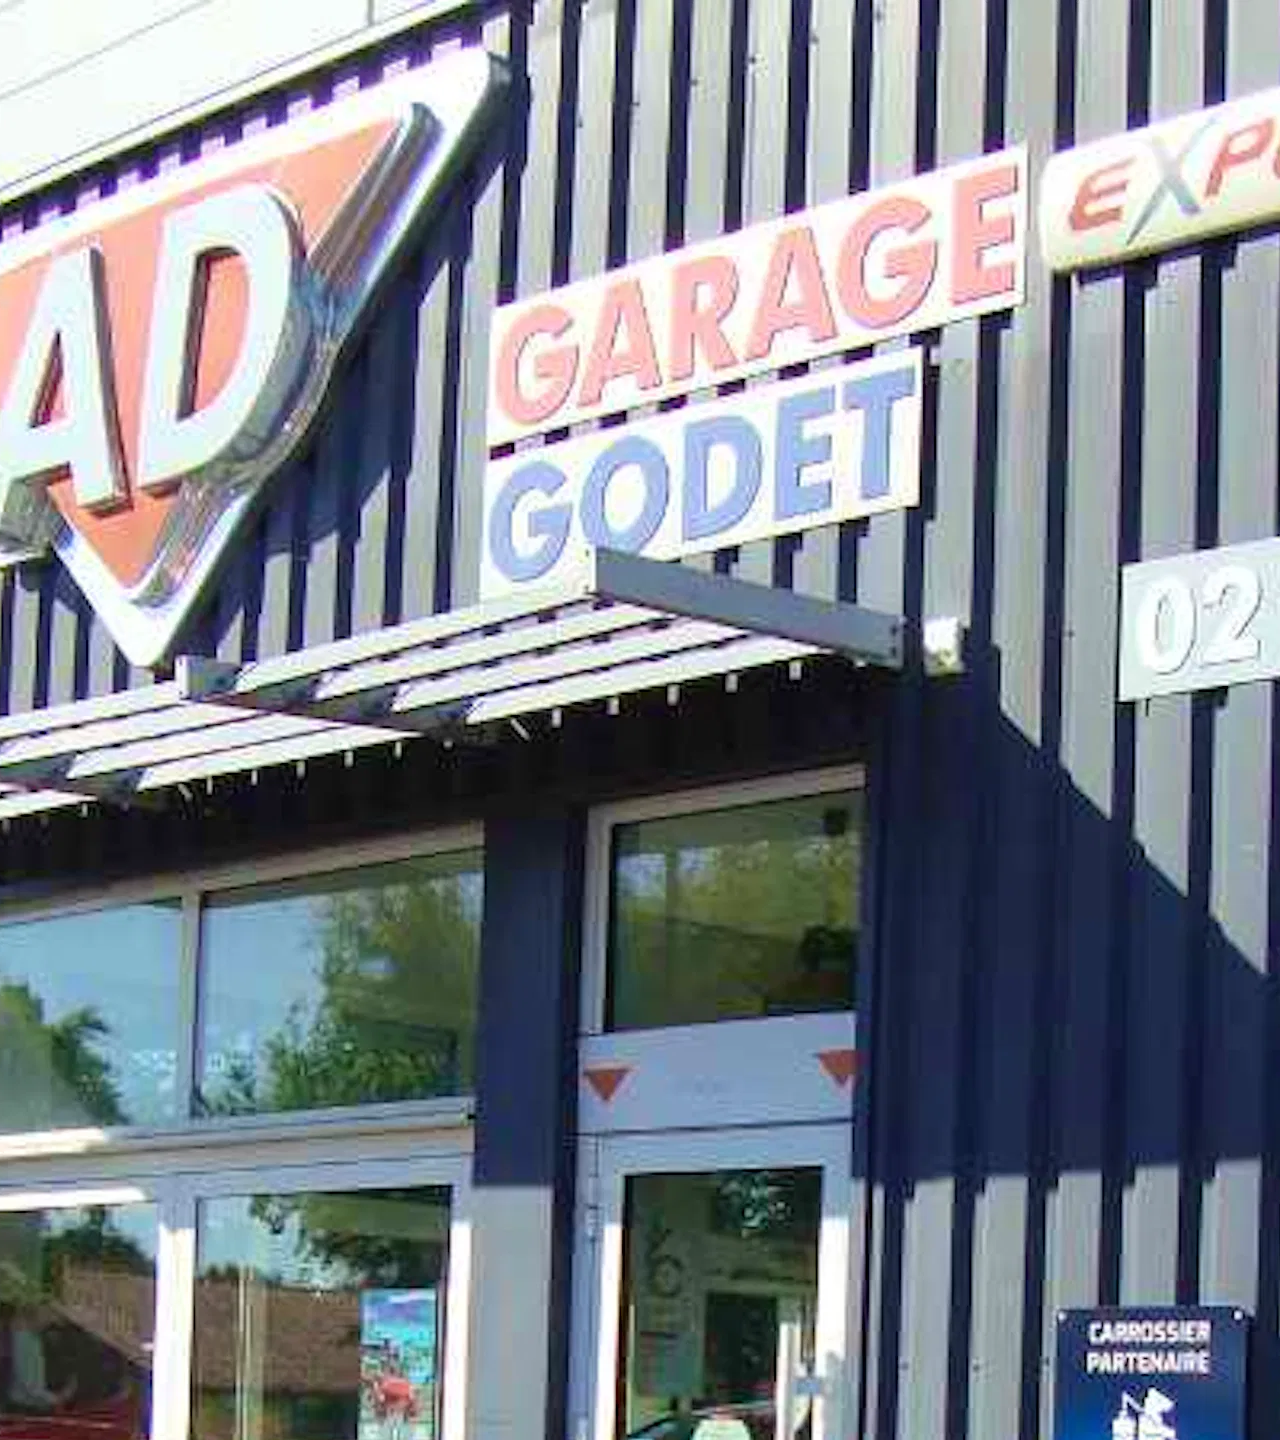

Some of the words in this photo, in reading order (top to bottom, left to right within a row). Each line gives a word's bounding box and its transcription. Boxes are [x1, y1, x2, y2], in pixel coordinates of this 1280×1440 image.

[494, 165, 1018, 425] GARAGE
[489, 366, 917, 583] GODET
[1133, 563, 1263, 675] 02
[1086, 1351, 1212, 1375] PARTENAIRE
[1089, 1320, 1212, 1345] CARROSSIER
